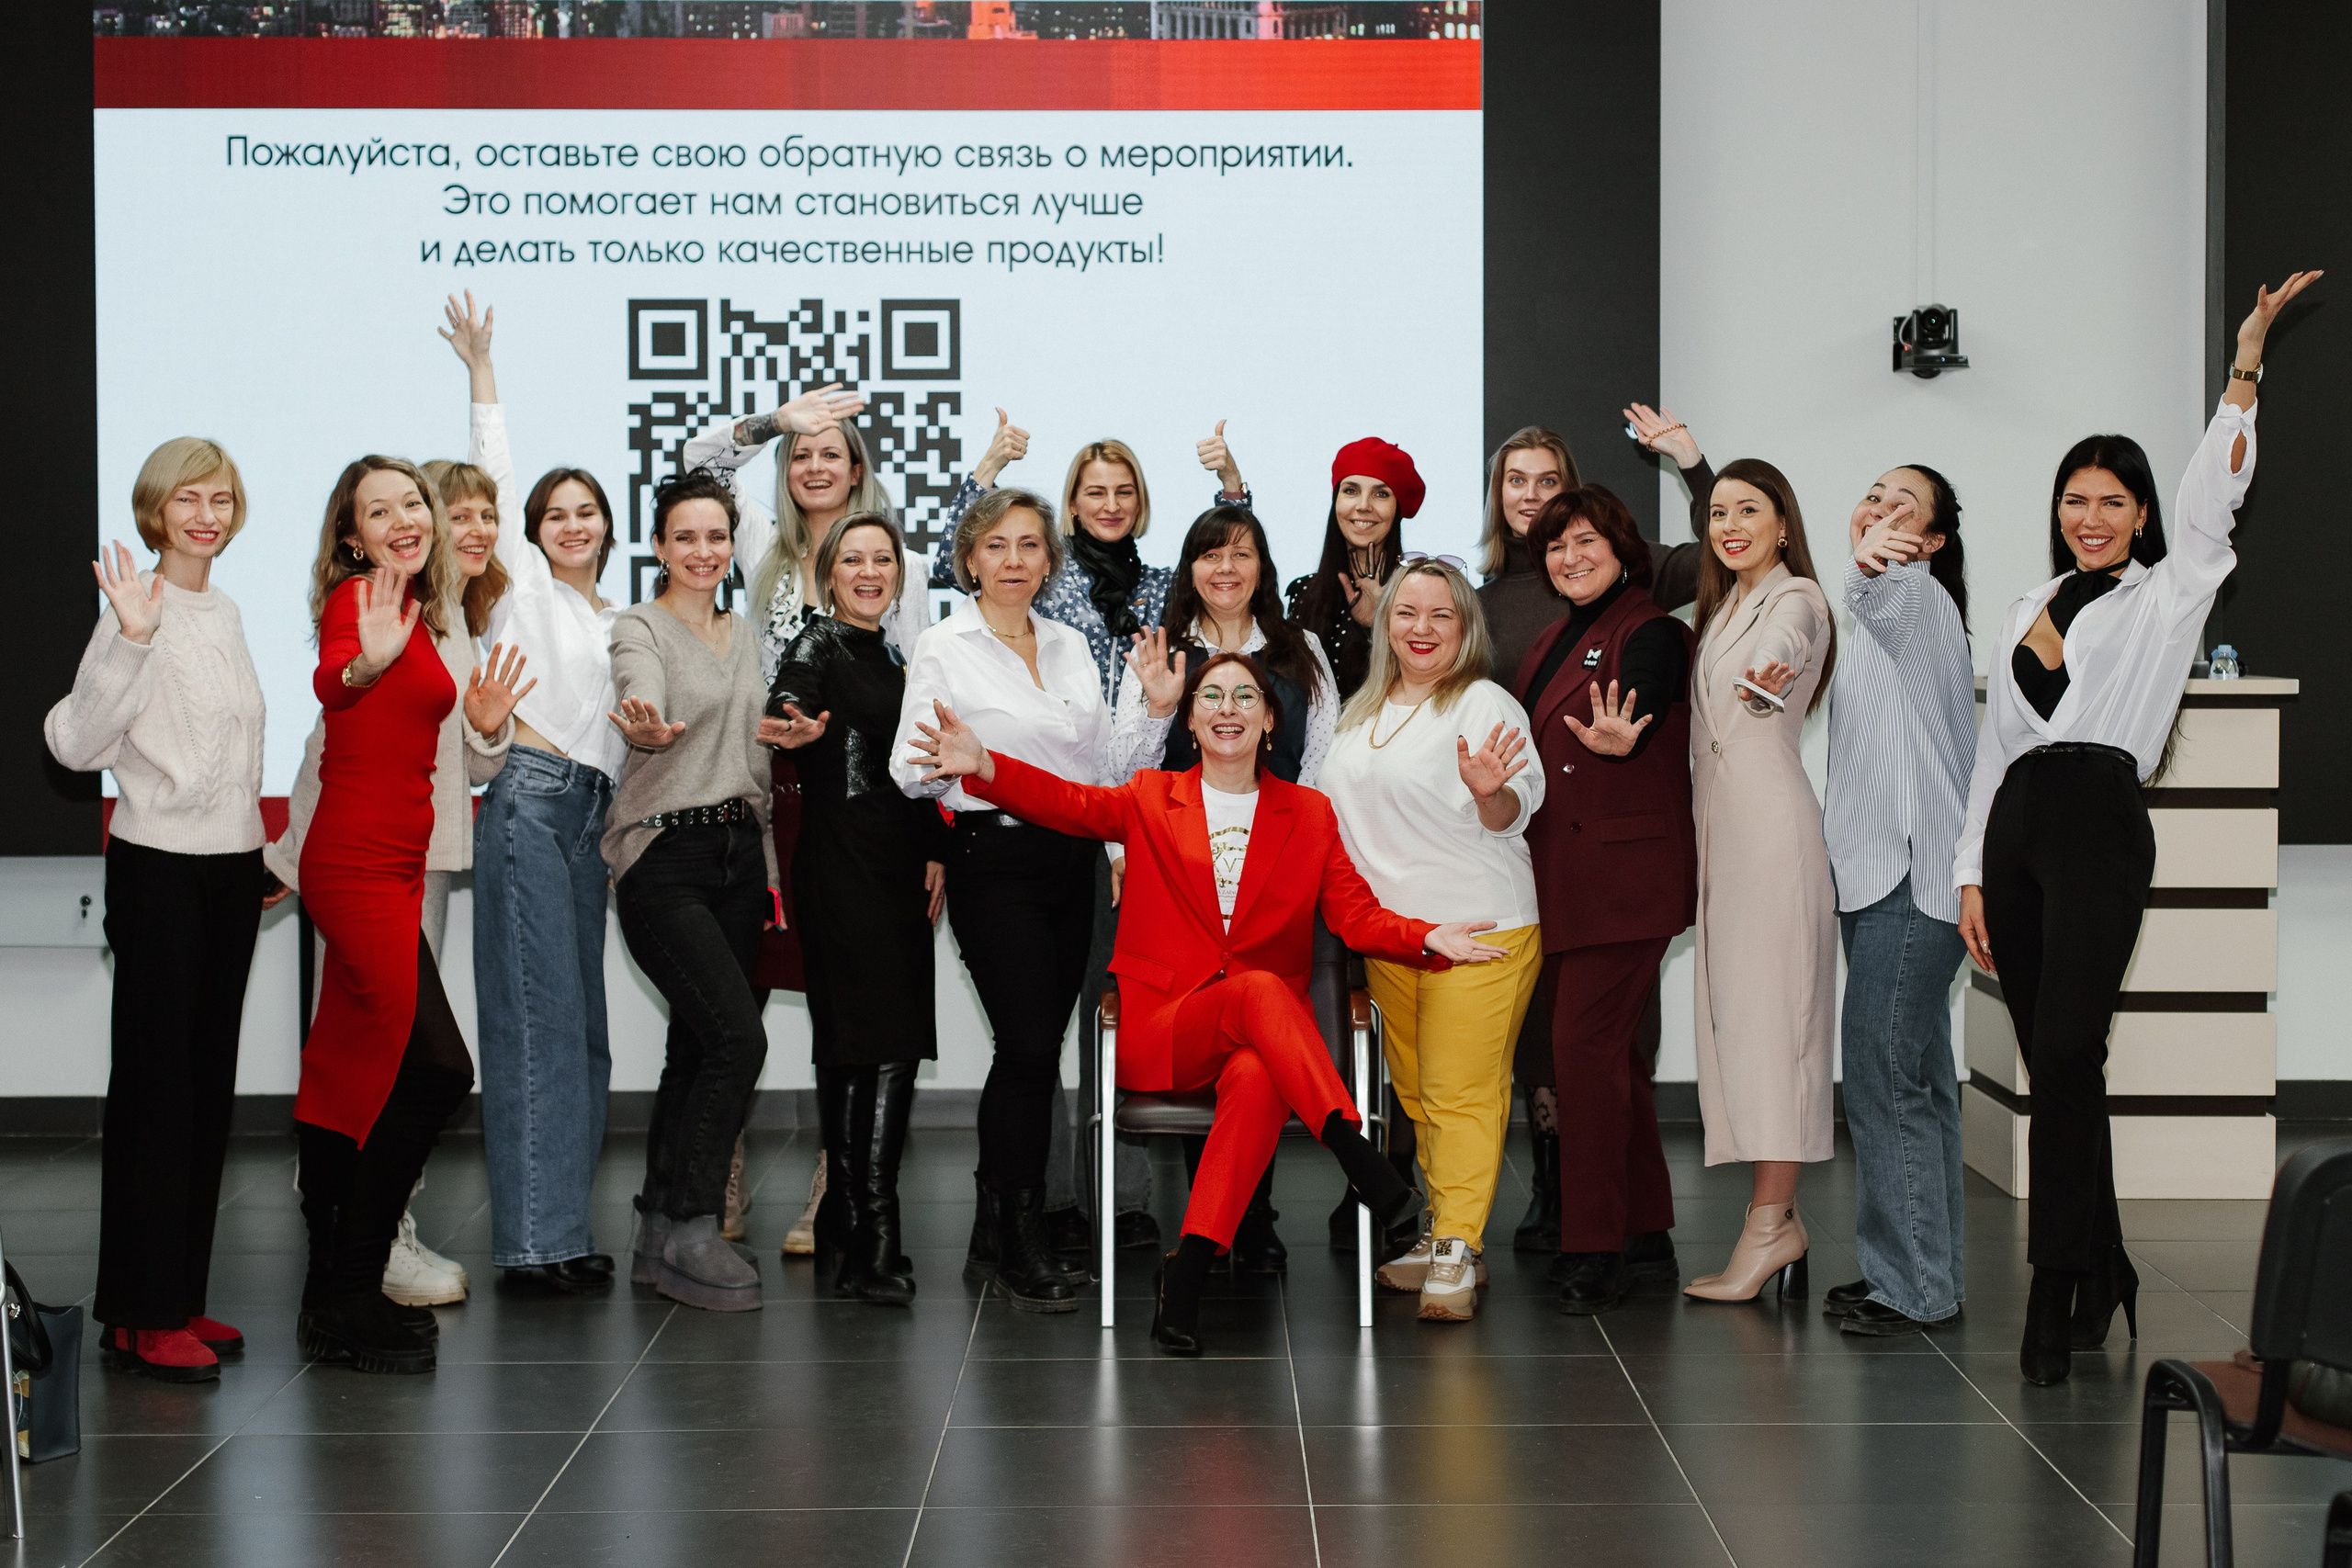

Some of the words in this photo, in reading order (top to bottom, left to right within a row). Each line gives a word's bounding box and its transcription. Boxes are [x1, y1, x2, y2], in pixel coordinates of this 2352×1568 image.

[228, 136, 459, 175] Пожалуйста,
[477, 145, 639, 166] оставьте
[653, 145, 745, 167] свою
[760, 135, 941, 175] обратную
[956, 145, 1051, 167] связь
[1066, 145, 1086, 167] о
[1102, 145, 1352, 175] мероприятии.
[444, 185, 510, 214] Это
[525, 193, 696, 214] помогает
[712, 194, 781, 214] нам
[797, 194, 1018, 215] становиться
[1033, 194, 1143, 223] лучше
[422, 242, 440, 262] и
[454, 241, 574, 266] делать
[589, 242, 704, 263] только
[719, 242, 973, 263] качественные
[989, 233, 1162, 272] продукты!
